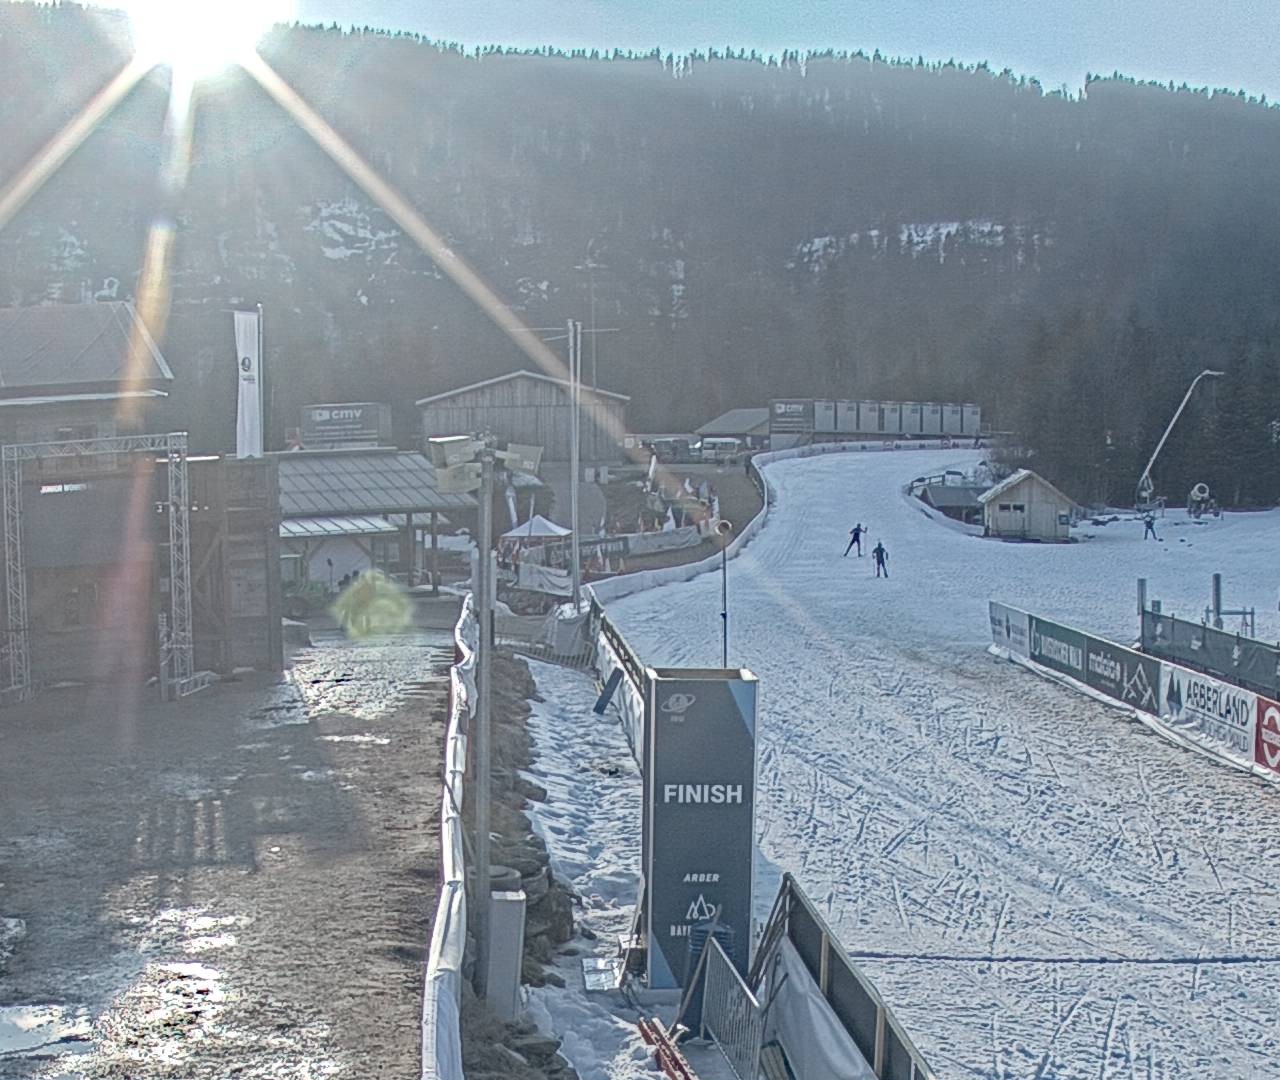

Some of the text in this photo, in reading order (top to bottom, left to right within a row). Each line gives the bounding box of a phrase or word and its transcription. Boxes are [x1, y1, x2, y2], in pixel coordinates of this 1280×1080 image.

[331, 409, 363, 420] cmv
[1186, 679, 1250, 727] ARBERLAND
[663, 784, 743, 804] FINISH
[682, 873, 720, 882] ARBER
